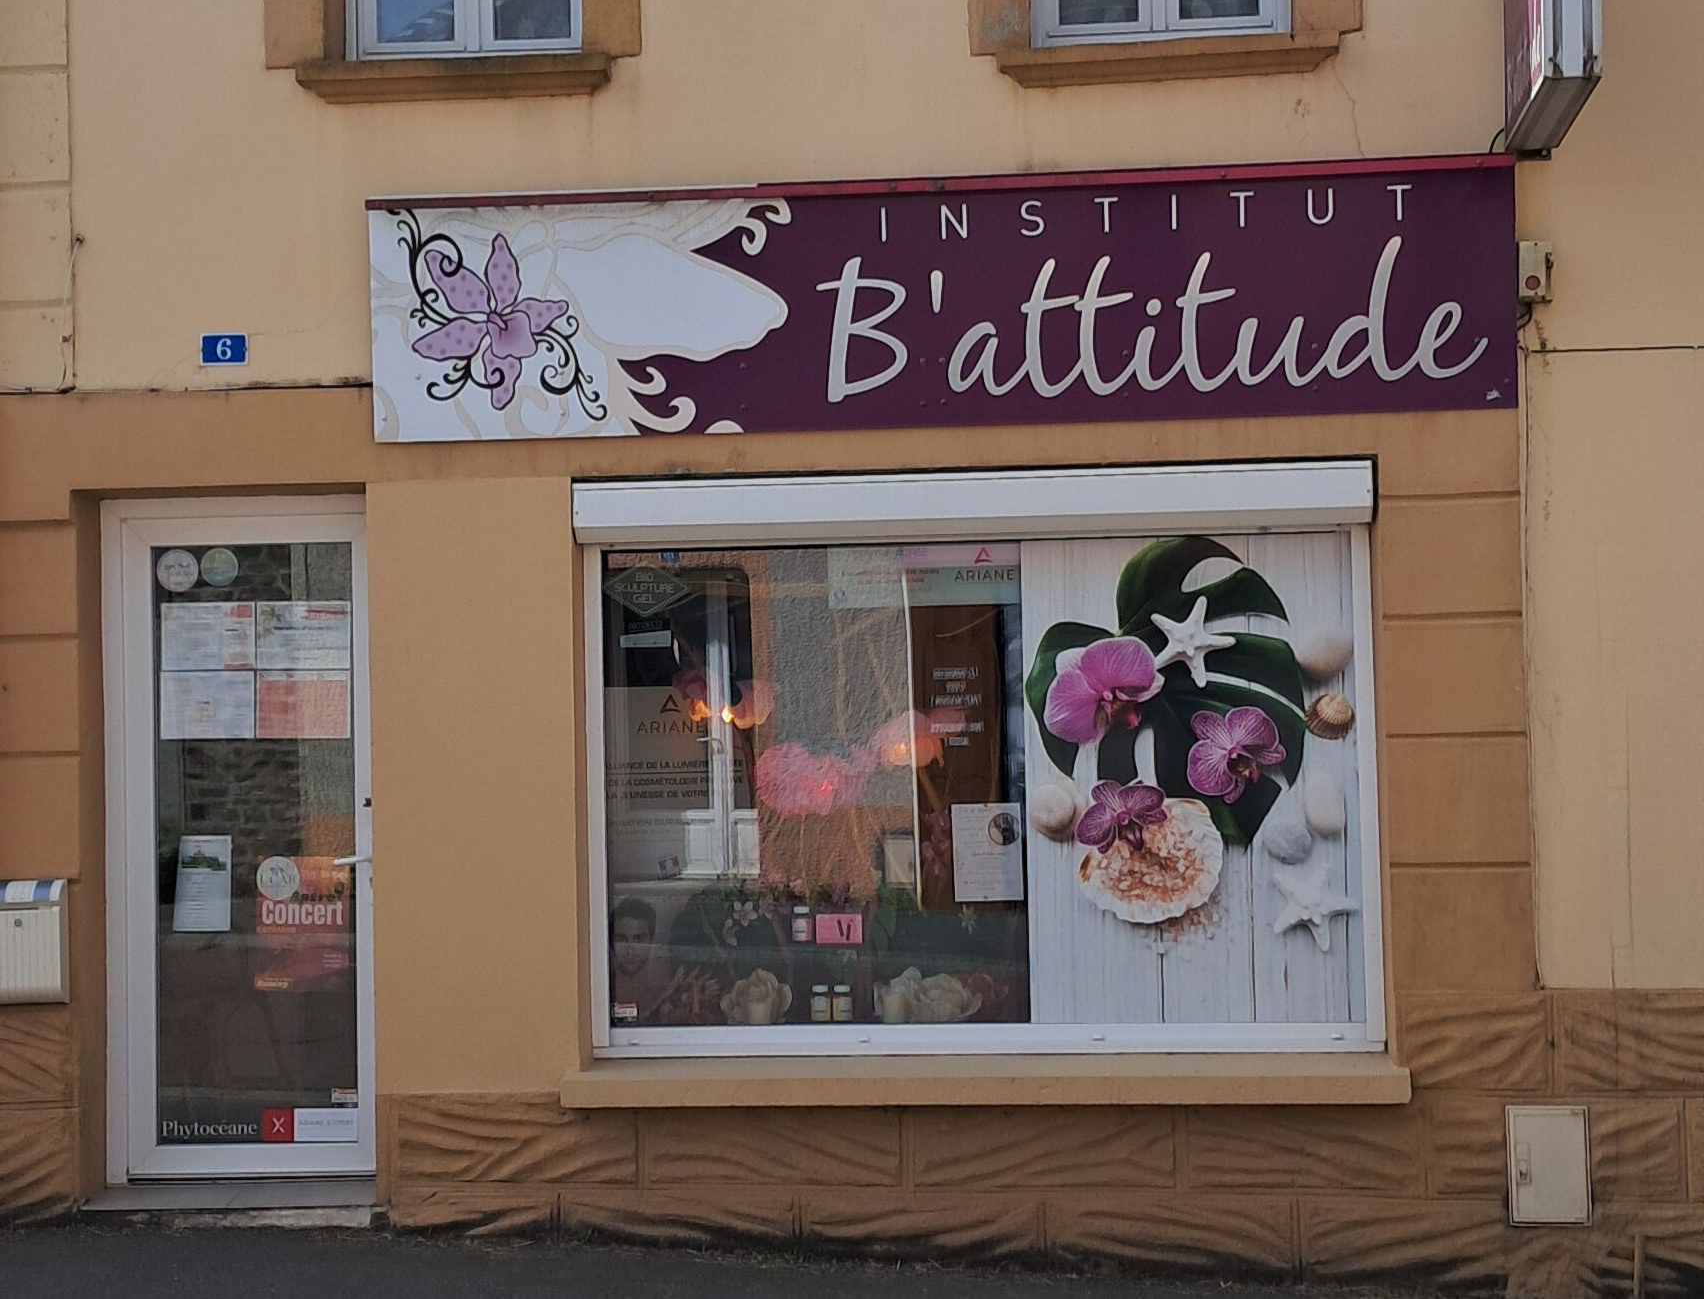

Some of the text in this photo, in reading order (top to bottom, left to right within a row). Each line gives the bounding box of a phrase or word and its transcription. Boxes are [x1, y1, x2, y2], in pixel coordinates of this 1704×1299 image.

[880, 184, 1413, 243] INSTITUT
[815, 235, 1489, 403] B'attitude
[216, 337, 232, 360] 6
[954, 568, 1016, 583] ARIANE
[613, 582, 675, 594] SCULPTURE
[632, 593, 655, 604] GEL
[636, 720, 707, 735] ARIANE
[646, 759, 659, 770] DE
[660, 759, 671, 769] LA
[261, 900, 344, 926] Concert
[161, 1119, 258, 1141] Phytocéane
